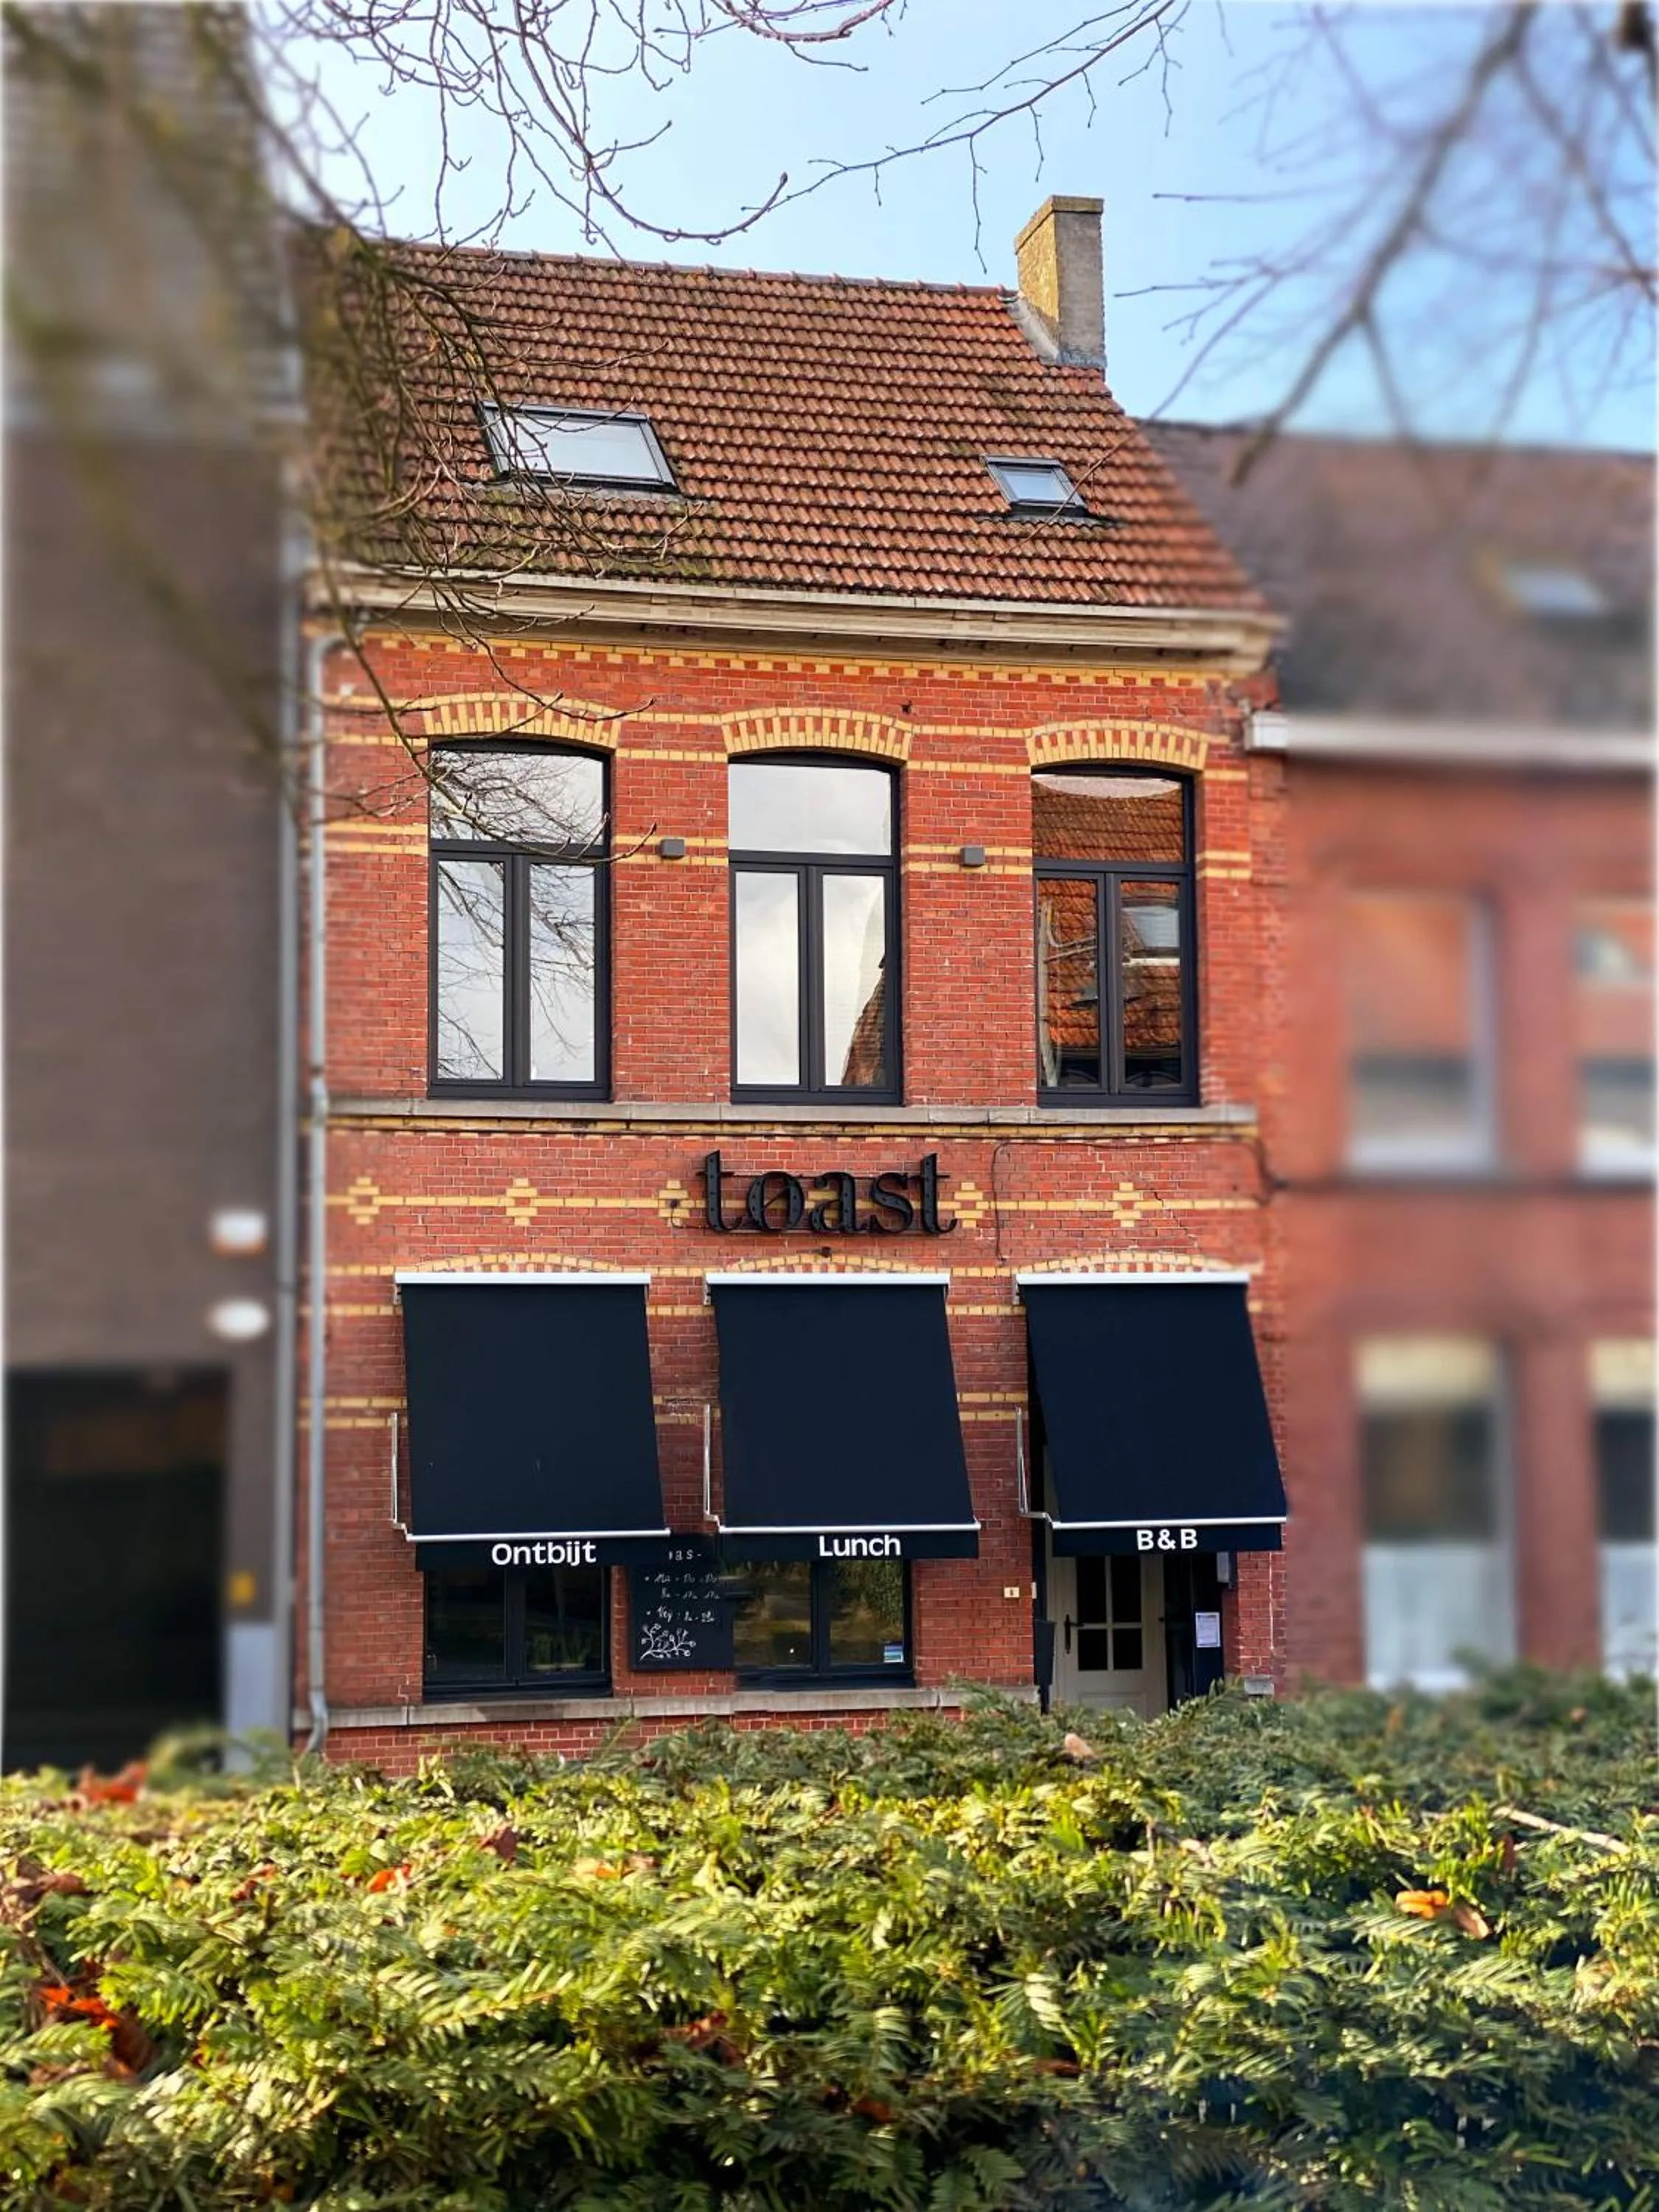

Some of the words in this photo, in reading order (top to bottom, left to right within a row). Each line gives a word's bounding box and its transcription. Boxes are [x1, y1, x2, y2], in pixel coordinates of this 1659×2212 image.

[695, 1149, 958, 1236] toast
[818, 1534, 901, 1557] Lunch
[1136, 1528, 1198, 1551] B&B
[491, 1540, 597, 1566] Ontbijt
